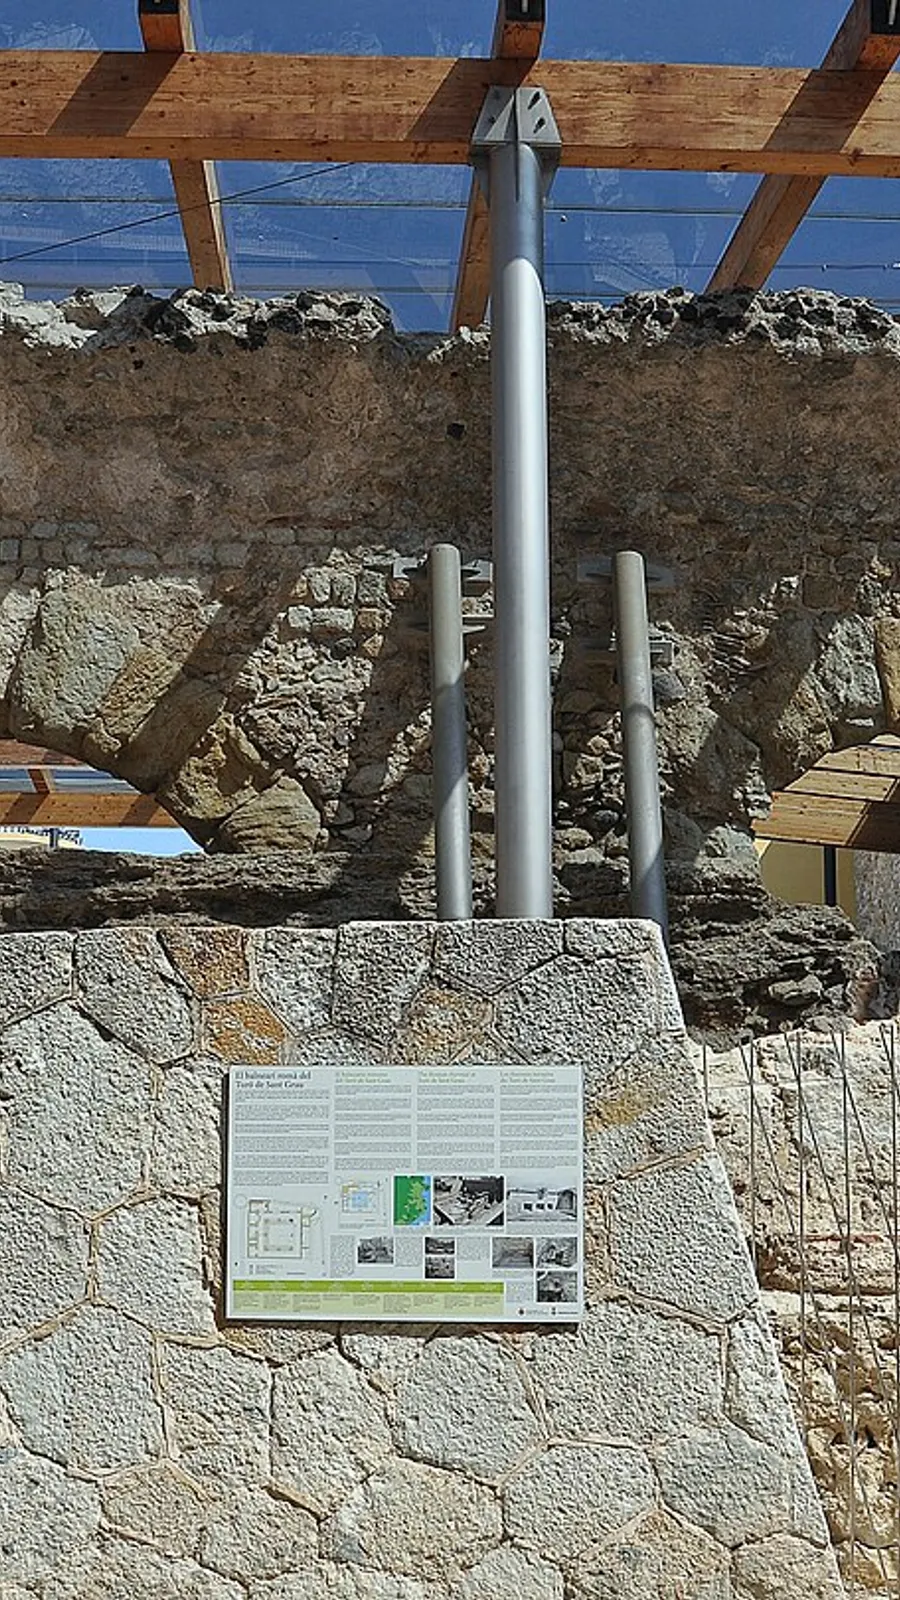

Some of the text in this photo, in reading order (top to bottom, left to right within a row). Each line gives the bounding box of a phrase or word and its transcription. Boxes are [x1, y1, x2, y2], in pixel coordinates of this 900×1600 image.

[235, 1070, 243, 1080] El
[245, 1070, 275, 1080] balneari
[299, 1070, 311, 1080] del
[266, 1080, 281, 1088] Sant
